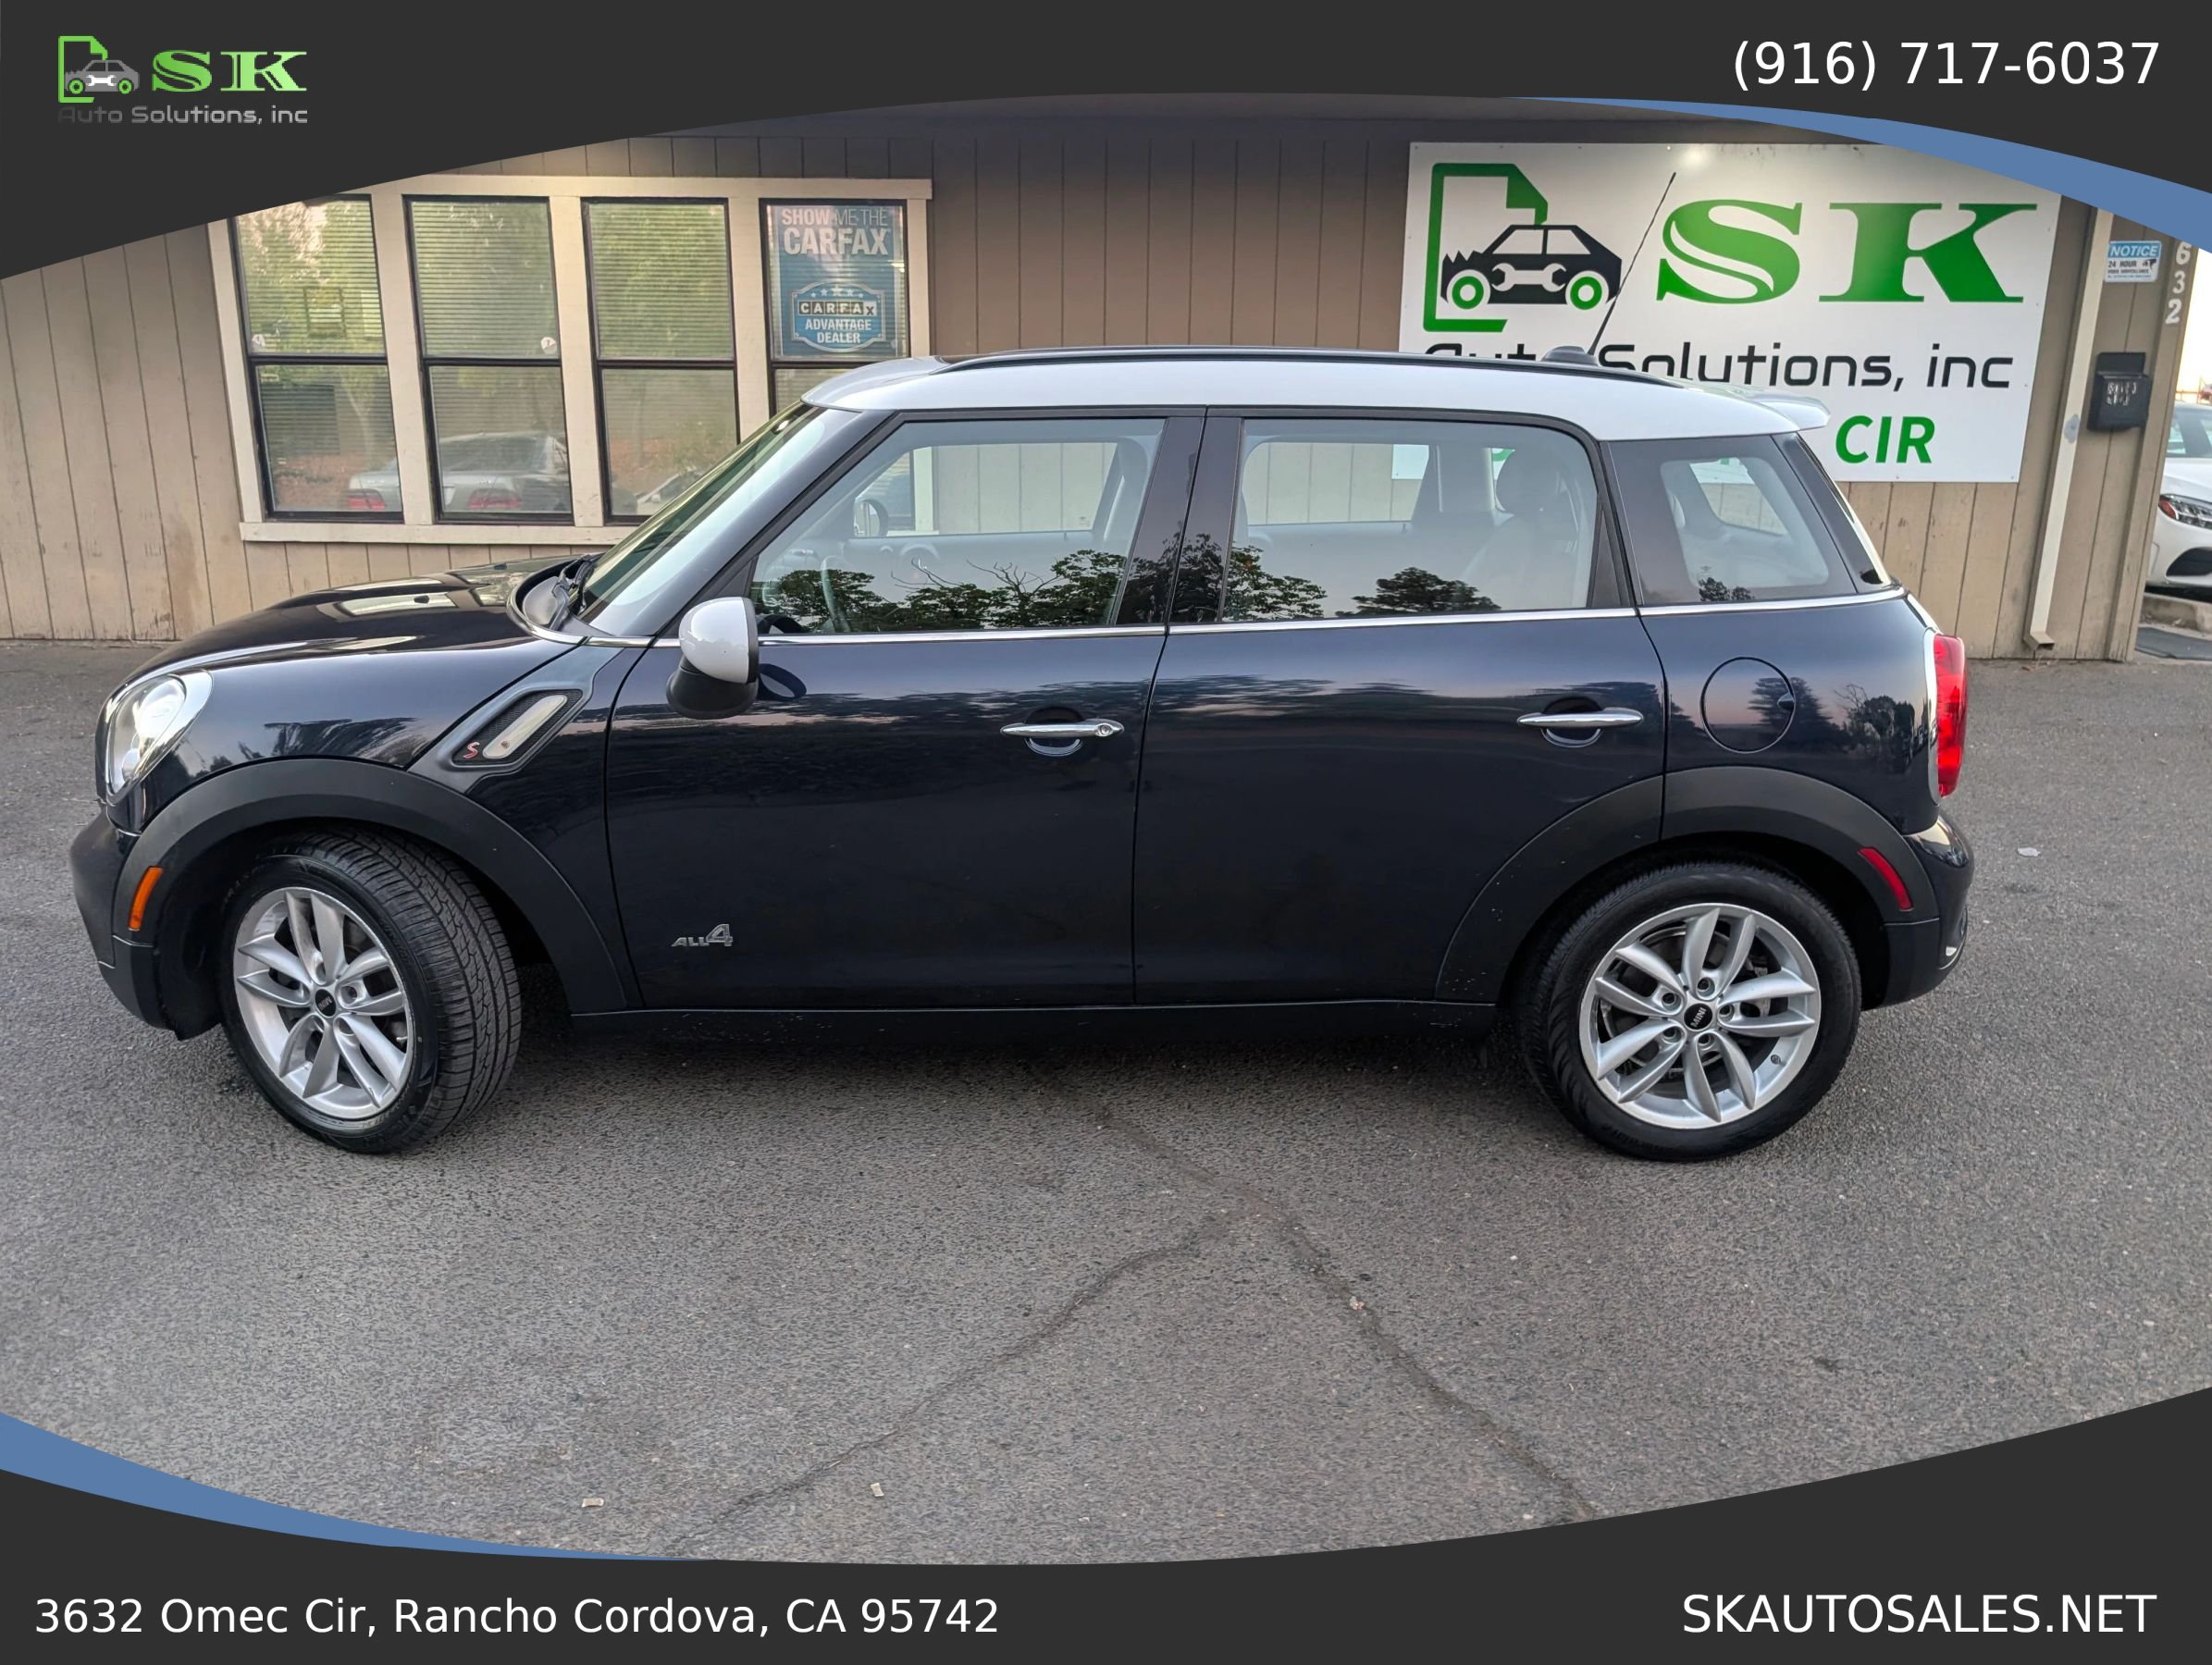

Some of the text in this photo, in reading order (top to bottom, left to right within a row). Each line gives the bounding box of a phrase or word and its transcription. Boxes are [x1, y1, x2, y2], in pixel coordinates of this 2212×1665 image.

[782, 208, 889, 226] SHOW ME THE
[784, 228, 890, 255] CARFAX
[2110, 244, 2159, 257] NOTICE
[1656, 199, 2037, 304] SK
[798, 301, 877, 315] CARFAX
[805, 318, 872, 331] ADVANTAGE
[817, 331, 860, 344] DEALER
[1599, 342, 2014, 392] Solutions, inc
[1835, 414, 1936, 464] CIR
[463, 741, 480, 759] S
[1690, 1006, 1707, 1028] MINI
